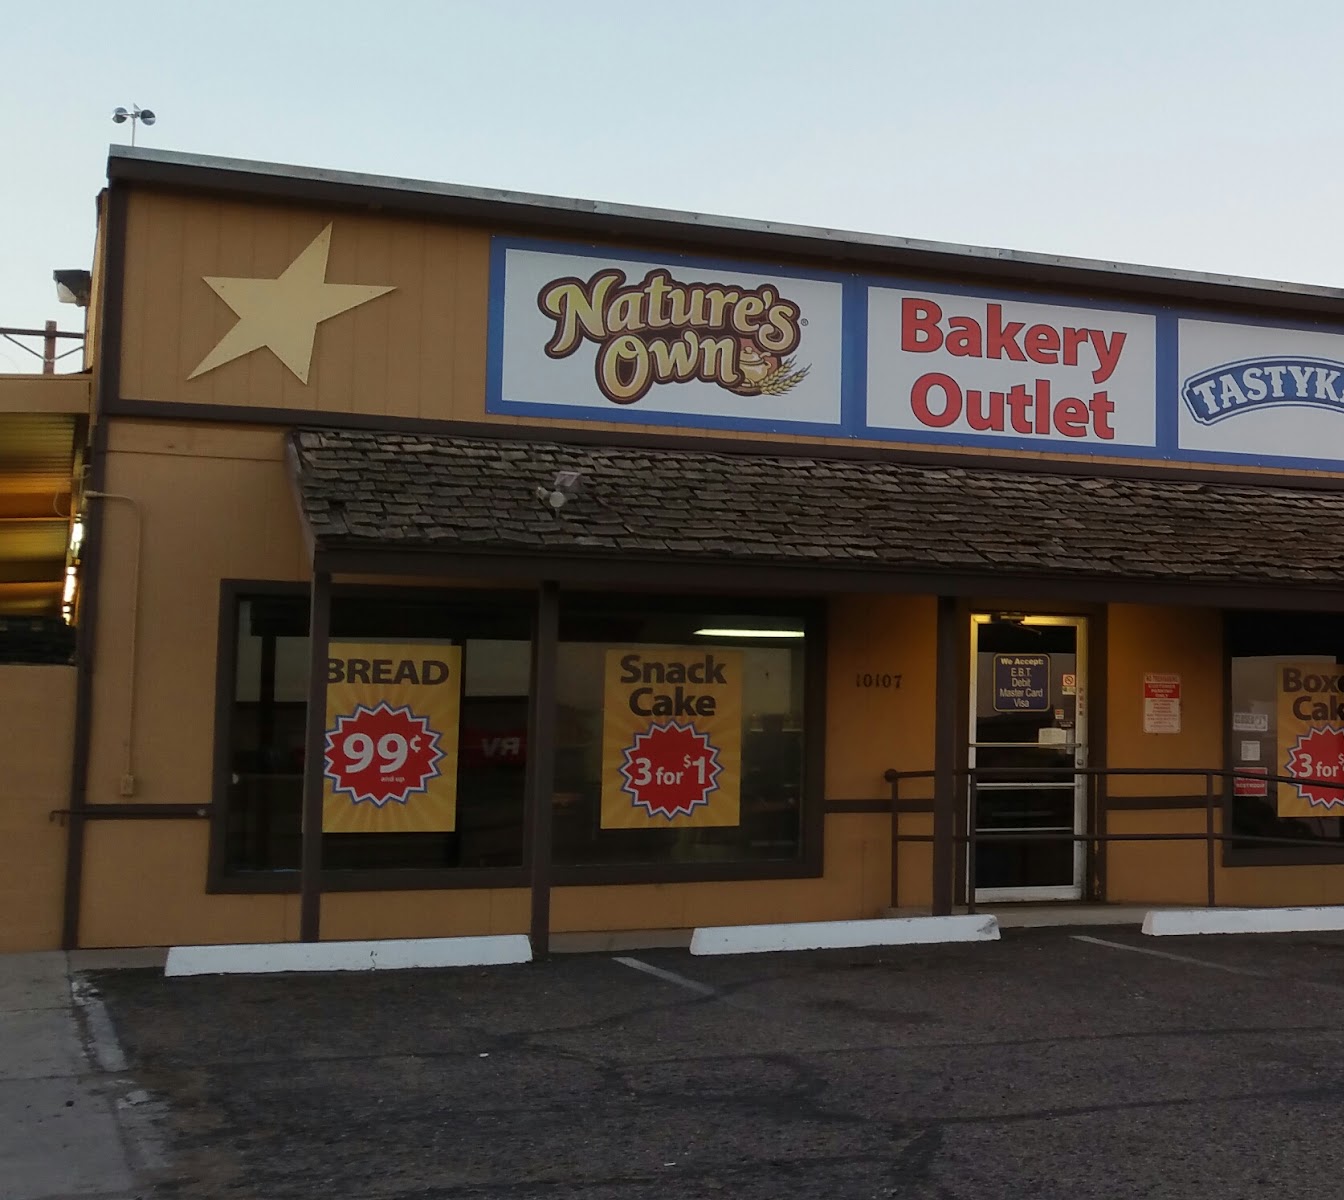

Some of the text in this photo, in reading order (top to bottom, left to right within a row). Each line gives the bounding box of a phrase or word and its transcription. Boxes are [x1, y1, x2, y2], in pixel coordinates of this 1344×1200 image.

[541, 271, 798, 355] Nature's
[901, 298, 1127, 384] Bakery
[598, 331, 741, 402] Own
[910, 372, 1115, 439] Outlet
[326, 657, 449, 685] BREAD
[620, 654, 727, 684] Snack
[856, 673, 902, 688] 10107
[1011, 677, 1031, 687] Debit
[629, 687, 716, 717] Cake
[1000, 688, 1043, 697] Master Card
[1014, 698, 1029, 707] Visa
[635, 755, 706, 785] 3 for $1
[1298, 753, 1313, 777] 3
[1315, 762, 1339, 777] for
